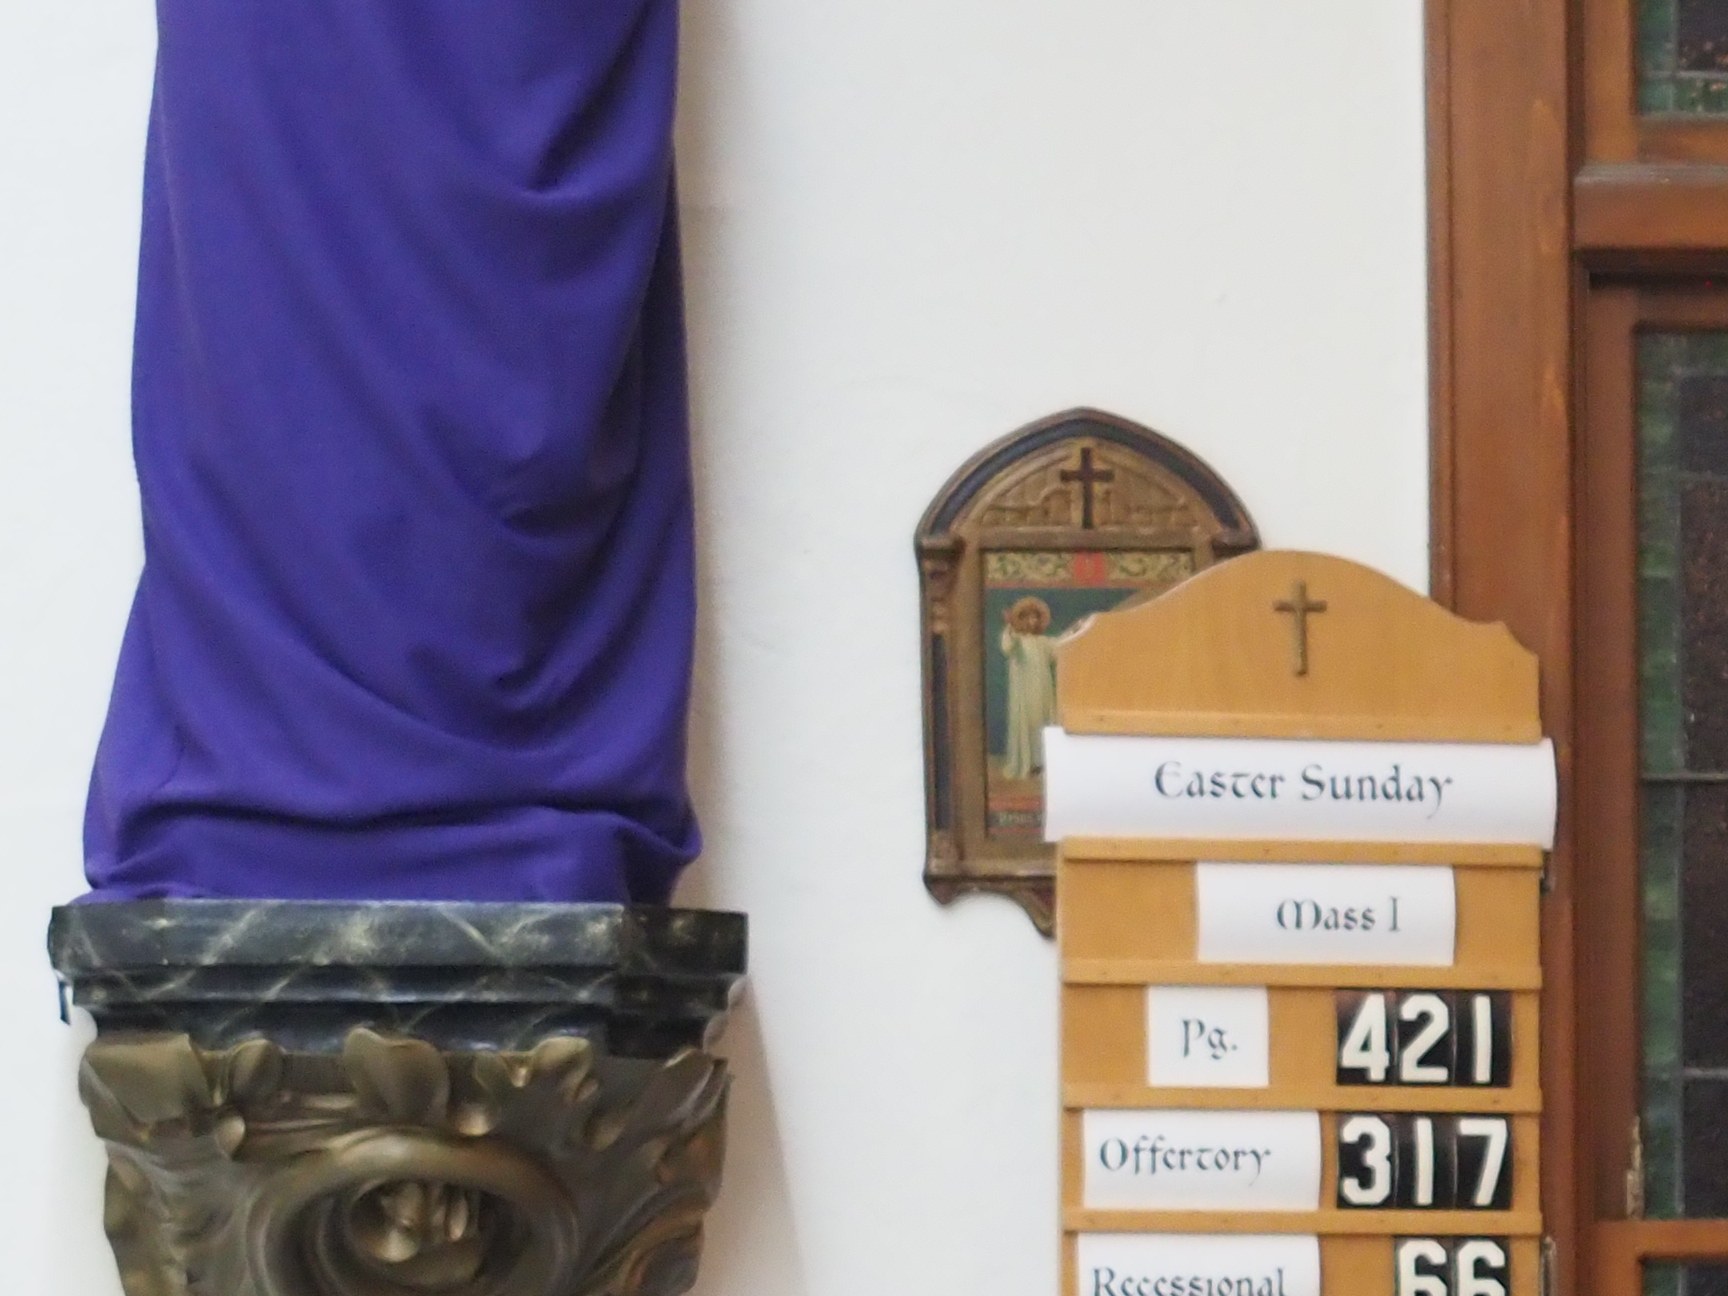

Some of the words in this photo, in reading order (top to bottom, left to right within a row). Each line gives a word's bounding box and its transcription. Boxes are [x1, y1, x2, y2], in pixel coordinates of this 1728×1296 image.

[1154, 761, 1285, 801] Easter
[1300, 764, 1453, 819] Sunday
[1275, 896, 1376, 932] Mass
[1180, 1017, 1238, 1061] Pg.
[1340, 993, 1492, 1084] 421
[1099, 1136, 1272, 1184] Offertory
[1341, 1116, 1508, 1206] 317
